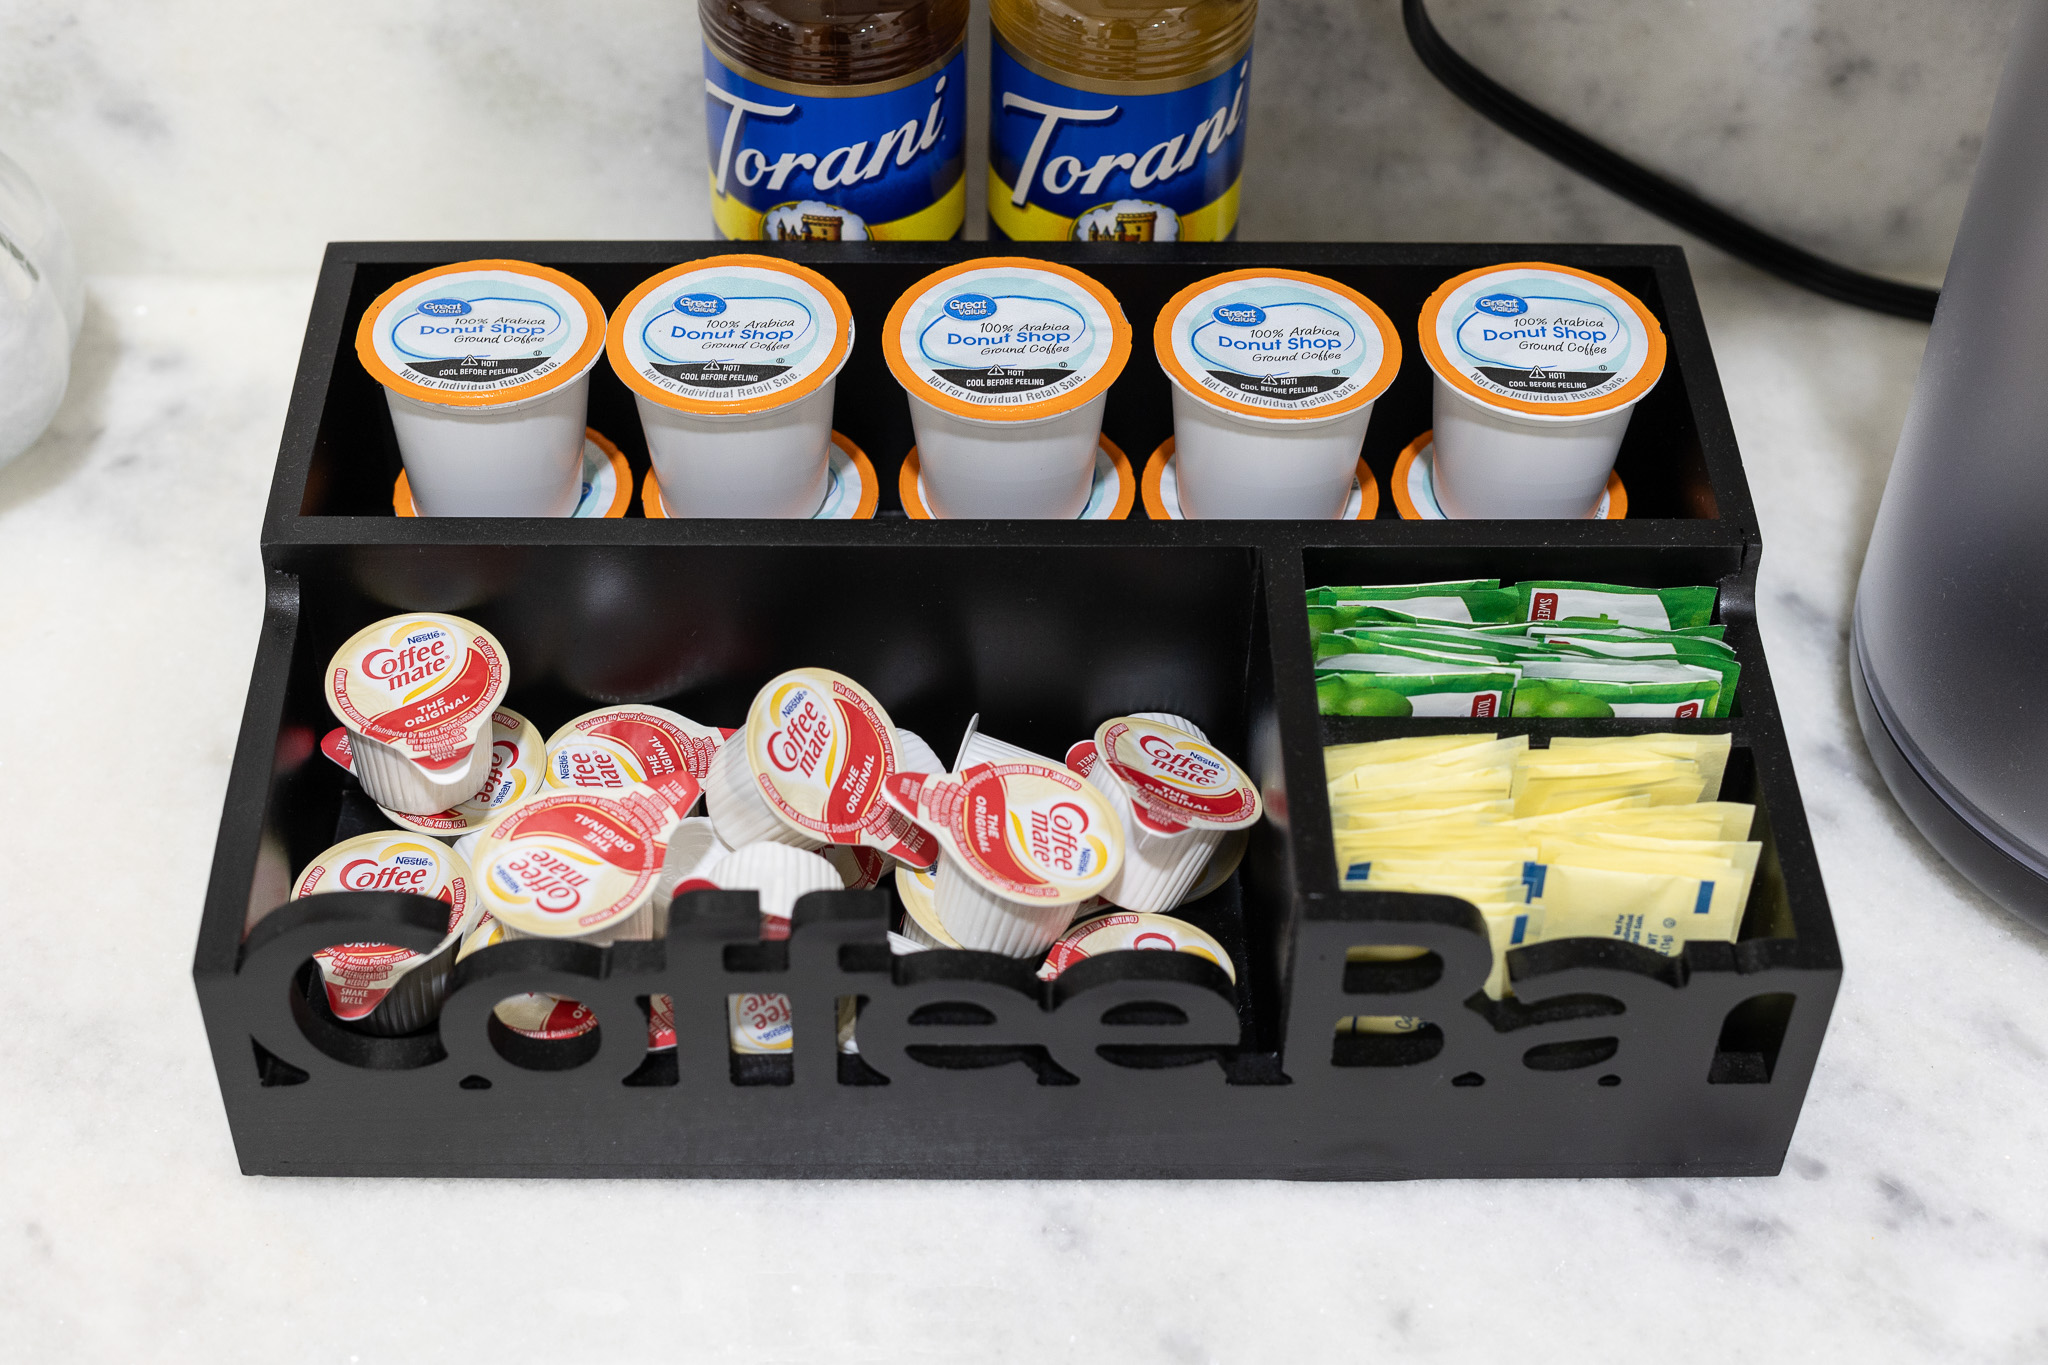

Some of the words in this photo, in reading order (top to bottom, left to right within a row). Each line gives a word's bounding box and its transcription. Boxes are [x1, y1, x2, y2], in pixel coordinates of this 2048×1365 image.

[705, 74, 948, 194] Torani
[1002, 60, 1248, 206] Torani
[680, 298, 718, 308] Great
[950, 300, 987, 310] Great
[1480, 299, 1519, 308] Great
[495, 317, 545, 325] Arabica
[1219, 309, 1256, 319] Great
[1515, 318, 1547, 326] 100%
[1554, 317, 1603, 327] Arabica
[420, 324, 484, 335] Donut
[491, 324, 545, 336] Shop
[706, 320, 740, 328] 100%
[747, 319, 794, 328] Arabica
[980, 323, 1013, 333] 100%
[1019, 323, 1070, 331] Arabica
[1250, 329, 1284, 338] 100%
[1290, 326, 1340, 336] Arabica
[454, 335, 499, 343] Ground
[504, 335, 544, 344] Coffee
[671, 327, 734, 339] Donut
[740, 329, 793, 342] Shop
[948, 333, 1010, 345] Donut
[1017, 332, 1070, 344] Shop
[1484, 327, 1547, 341] Donut
[1553, 327, 1606, 343] Shop
[750, 342, 789, 351] Coffee
[981, 346, 1025, 355] Ground
[1029, 345, 1070, 355] Coffee
[1219, 336, 1281, 350] Donut
[1288, 337, 1341, 351] Shop
[1519, 341, 1564, 352] Ground
[1568, 343, 1607, 355] Coffee
[1252, 353, 1297, 362] Ground
[1301, 352, 1341, 361] Coffee
[400, 369, 417, 382] Not
[420, 376, 436, 387] For
[438, 382, 496, 391] Individual
[499, 373, 532, 388] Retail
[534, 361, 561, 376] Sale.
[642, 368, 660, 380] Not
[661, 379, 676, 390] For
[677, 385, 733, 398] Individual
[738, 383, 772, 398] Retail
[775, 373, 801, 387] Sale.
[927, 376, 943, 390] Not
[945, 385, 964, 397] For
[966, 392, 1022, 404] Individual
[1027, 386, 1058, 401] Retail
[1059, 375, 1086, 390] Sale.
[1201, 376, 1218, 391] Not
[1219, 387, 1238, 400] For
[1241, 393, 1297, 408] Individual
[1301, 393, 1333, 408] Retail
[1334, 383, 1359, 397] Sale.
[1261, 386, 1287, 394] BEFORE
[1289, 386, 1318, 394] PEELING
[1470, 372, 1488, 386] Not
[1490, 383, 1508, 394] For
[1510, 390, 1568, 401] Individual
[1572, 389, 1603, 403] Retail
[1603, 375, 1628, 391] Sale.
[362, 640, 444, 680] Coffee
[404, 694, 470, 728] ORIGINAL
[417, 697, 446, 714] THE
[372, 725, 407, 737] Distributed
[767, 701, 818, 772] Coffee
[648, 735, 677, 775] RIGINAL
[1076, 751, 1097, 768] WELL
[1139, 735, 1218, 778] Coffee
[646, 754, 663, 776] THE
[842, 764, 860, 793] THE
[846, 754, 874, 814] ORIGINAL
[661, 784, 684, 806] SHAKE
[669, 779, 688, 797] WELL
[1162, 786, 1190, 800] THE
[1144, 782, 1211, 812] ORIGINAL
[453, 820, 466, 828] USA
[975, 795, 991, 854] ORIGINAL
[987, 814, 999, 839] THE
[574, 813, 636, 853] ORIGINAL
[583, 828, 613, 853] THE
[902, 827, 920, 849] SHAKE
[1049, 801, 1089, 871] Coffee
[908, 836, 926, 854] WELL
[340, 859, 426, 892] Coffee
[509, 858, 581, 913] Coffee
[338, 951, 346, 961] By
[370, 950, 410, 966] Professional
[344, 969, 387, 980] REFRIGERATION
[236, 898, 1242, 1088] Coffee
[1290, 890, 1836, 1086] Bar
[341, 988, 368, 997] SHAKE
[341, 996, 363, 1005] WELL
